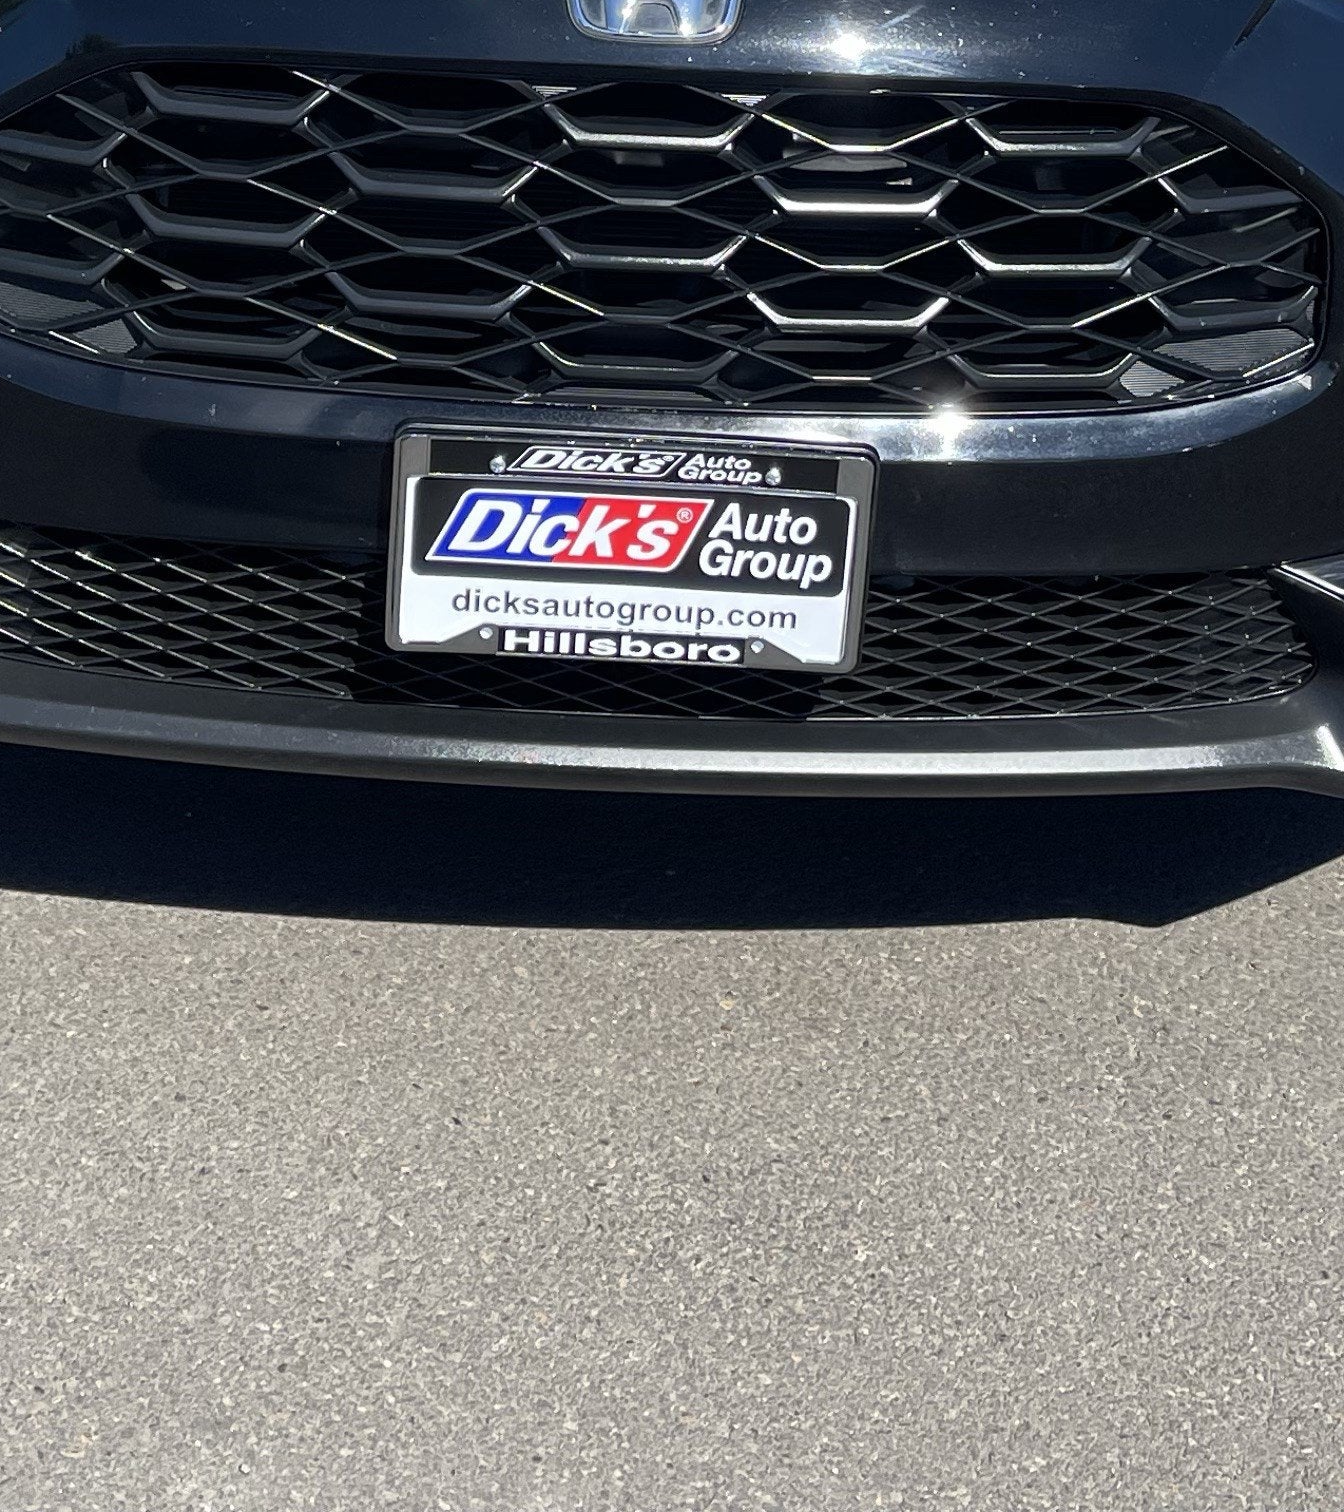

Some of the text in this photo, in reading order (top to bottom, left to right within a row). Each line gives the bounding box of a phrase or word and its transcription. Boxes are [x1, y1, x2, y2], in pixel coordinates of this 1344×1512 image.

[677, 466, 763, 485] Group
[683, 453, 752, 471] Auto
[707, 502, 818, 546] Auto
[698, 538, 833, 589] Group
[451, 588, 798, 630] dicksautogroup.com
[503, 629, 741, 662] Hillsboro
